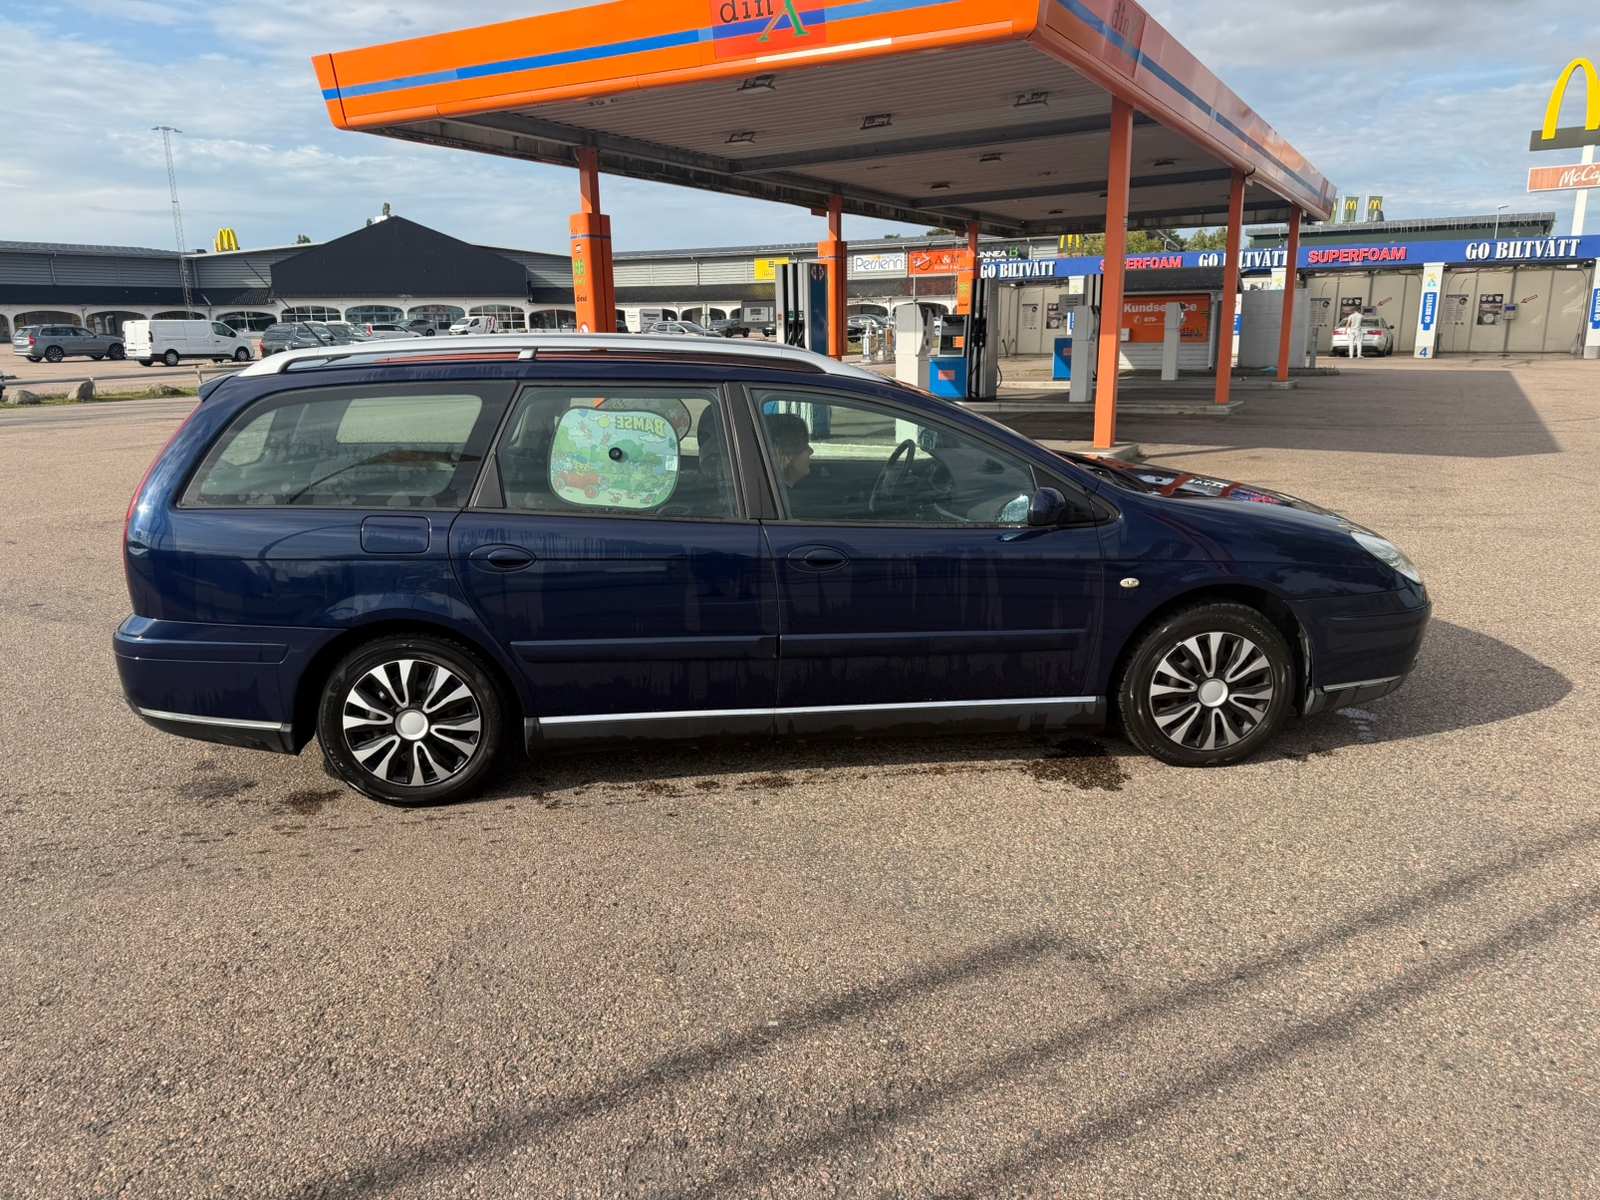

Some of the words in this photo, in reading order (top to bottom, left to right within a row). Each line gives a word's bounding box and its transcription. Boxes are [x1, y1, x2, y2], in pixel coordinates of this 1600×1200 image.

[1559, 165, 1600, 188] McCa
[1308, 246, 1407, 264] SUPERFOAM
[1466, 242, 1490, 260] GO
[1495, 237, 1580, 259] BILTVÄTT
[855, 257, 903, 270] Persienn
[1100, 256, 1182, 271] ERFOAM
[1198, 253, 1218, 267] GO
[1223, 248, 1287, 268] LTVÄTT
[980, 264, 997, 279] GO
[999, 259, 1055, 278] BILTVÄTT
[1123, 303, 1197, 313] Kundsece
[1419, 347, 1428, 357] 4
